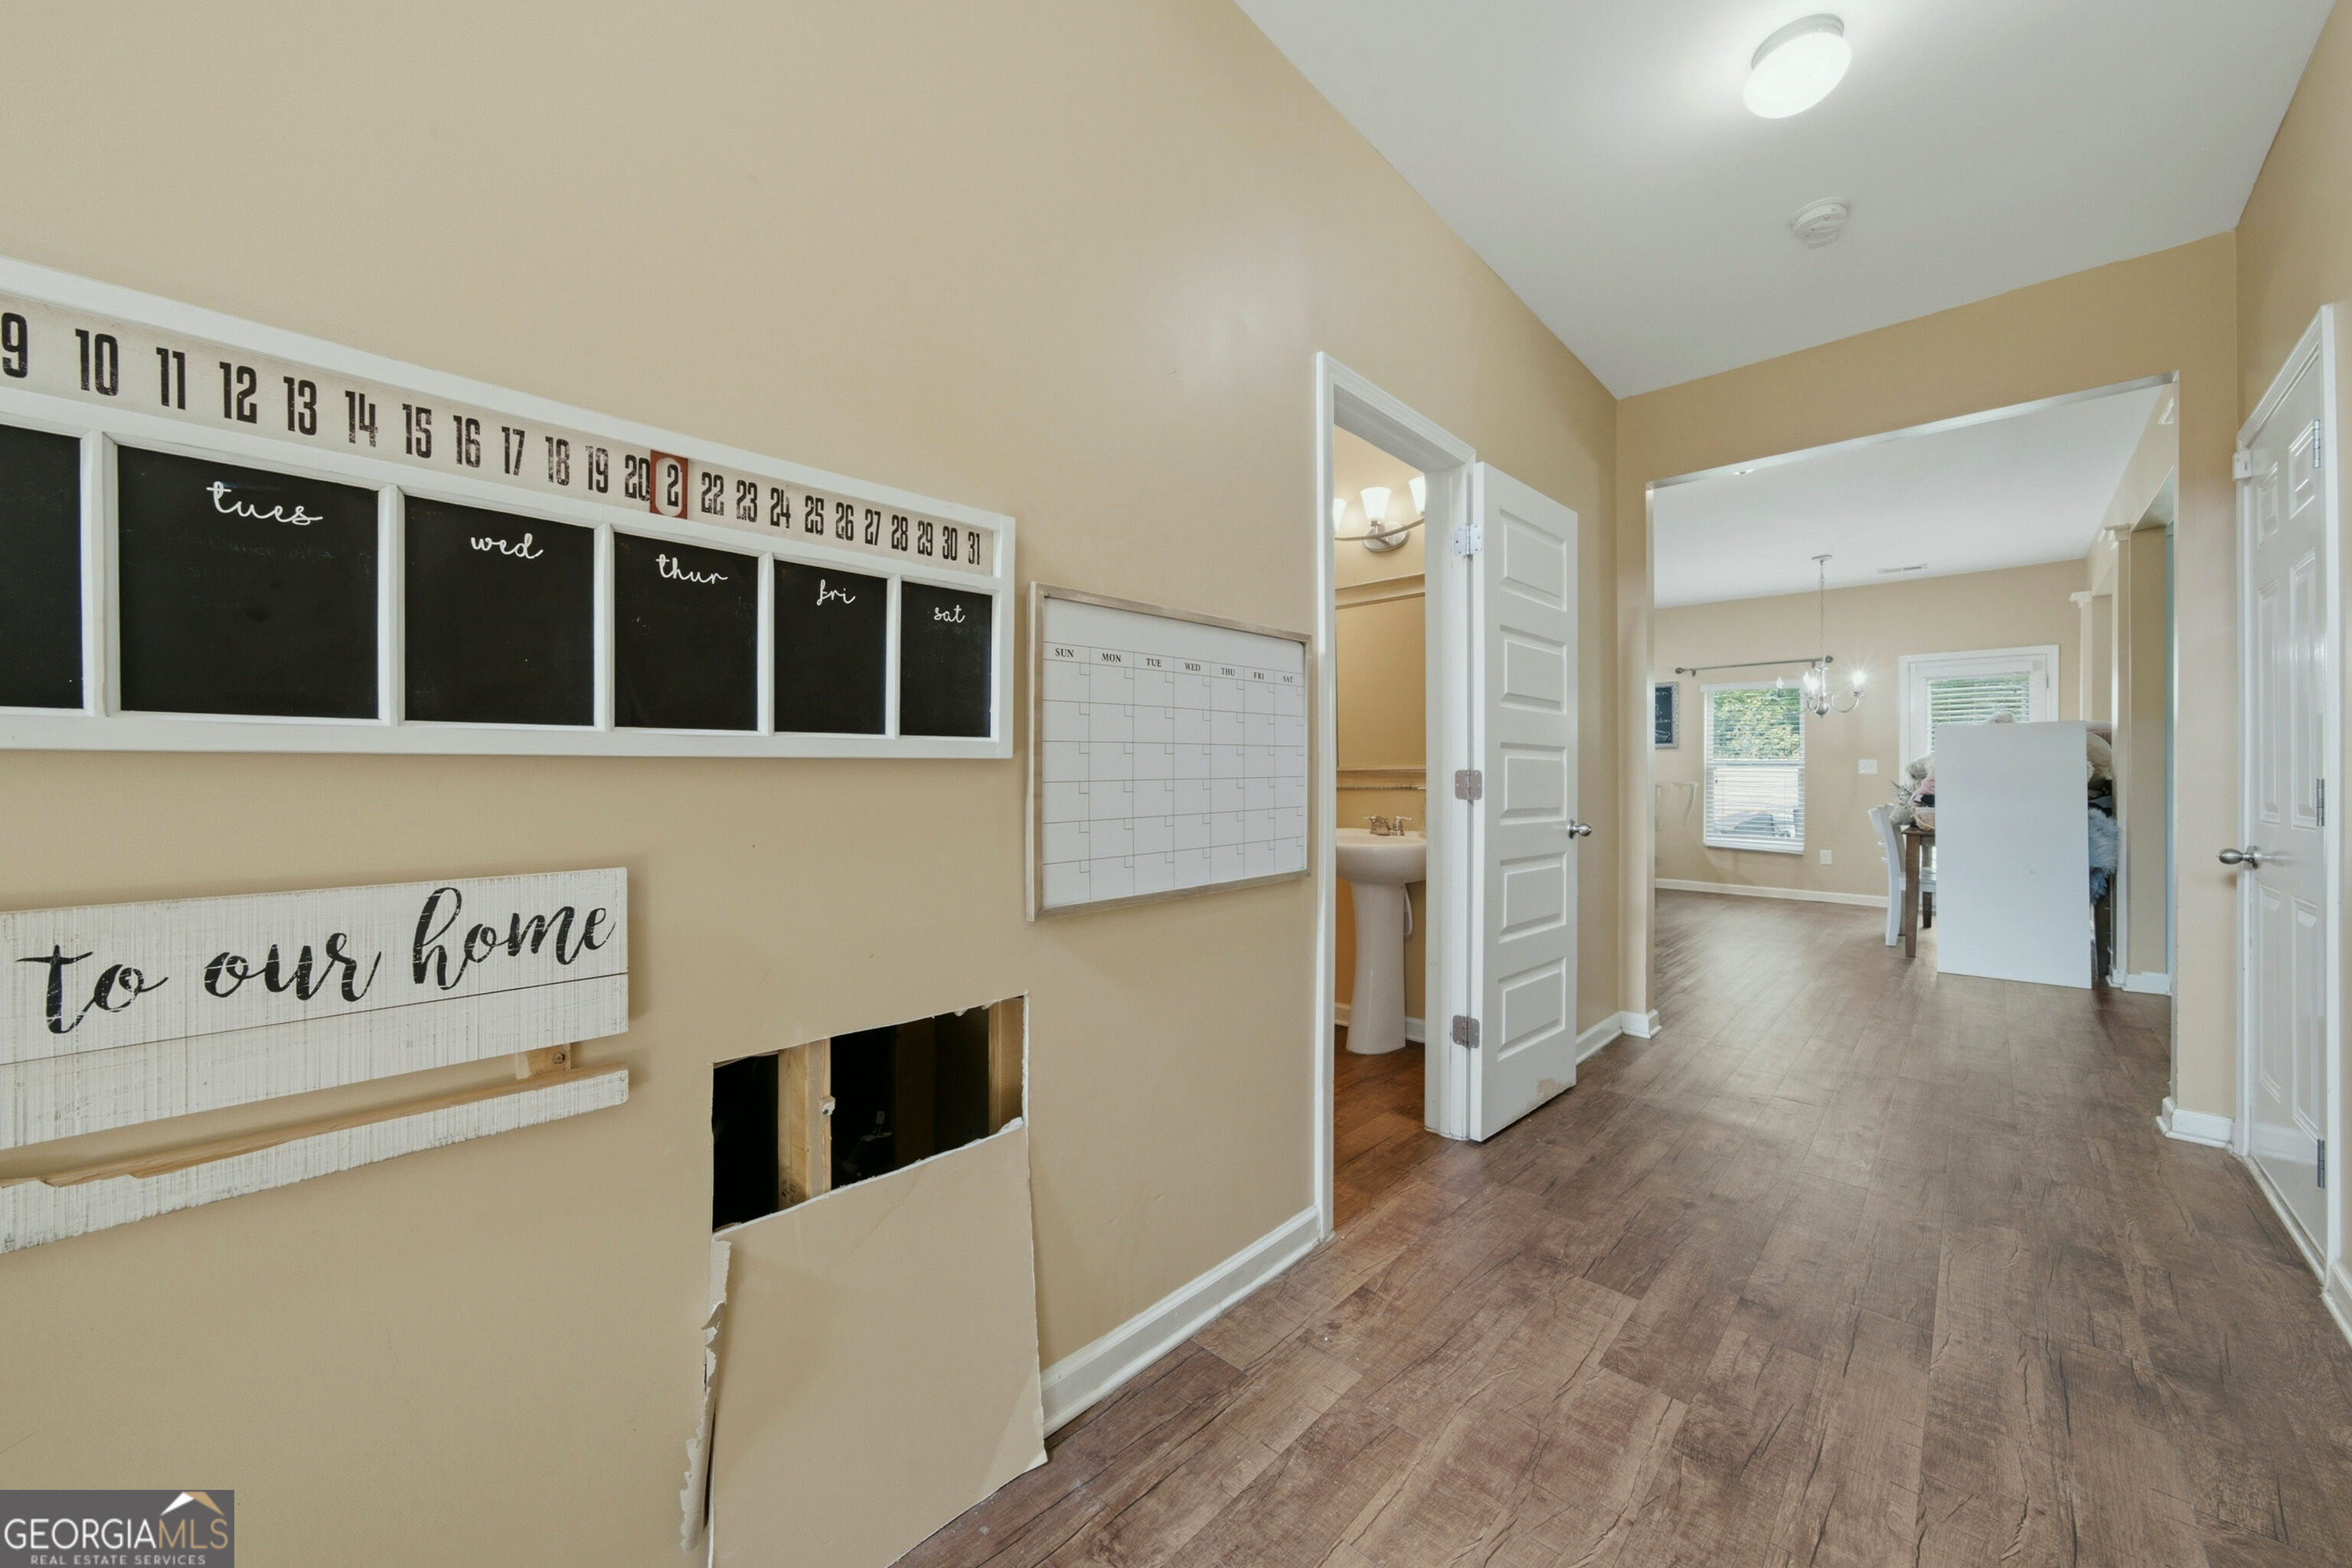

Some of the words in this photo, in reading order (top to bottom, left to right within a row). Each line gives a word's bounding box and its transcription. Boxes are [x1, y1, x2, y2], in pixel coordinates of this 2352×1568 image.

[2, 312, 28, 378] 9
[75, 328, 118, 396] 10
[156, 347, 185, 410] 11
[220, 361, 256, 423] 12
[283, 376, 316, 435] 13
[345, 390, 377, 446] 14
[403, 403, 431, 458] 15
[453, 415, 480, 467] 16
[501, 426, 524, 475] 17
[546, 436, 570, 485] 18
[586, 445, 609, 494] 19
[625, 455, 650, 501] 20
[667, 463, 683, 508] 2
[701, 472, 724, 515] 22
[737, 480, 757, 522] 23
[770, 488, 791, 528] 24
[805, 495, 824, 535] 25
[836, 502, 854, 541] 26
[865, 509, 880, 545] 27
[892, 514, 908, 551] 28
[918, 521, 933, 556] 29
[942, 526, 957, 560] 30
[969, 531, 980, 565] 31
[207, 481, 323, 525] tues
[470, 532, 544, 560] wed
[655, 554, 728, 585] thur
[816, 579, 856, 606] fri
[933, 604, 965, 623] sat
[1055, 648, 1074, 658] SUN
[1102, 652, 1122, 662] MON
[1145, 658, 1161, 668] TUE
[1184, 662, 1201, 671] WED
[1220, 667, 1234, 677] THU
[1253, 671, 1265, 680] FRI
[1282, 675, 1293, 684] SAT
[16, 945, 168, 1034] to
[204, 933, 381, 1001] our
[413, 887, 616, 990] home
